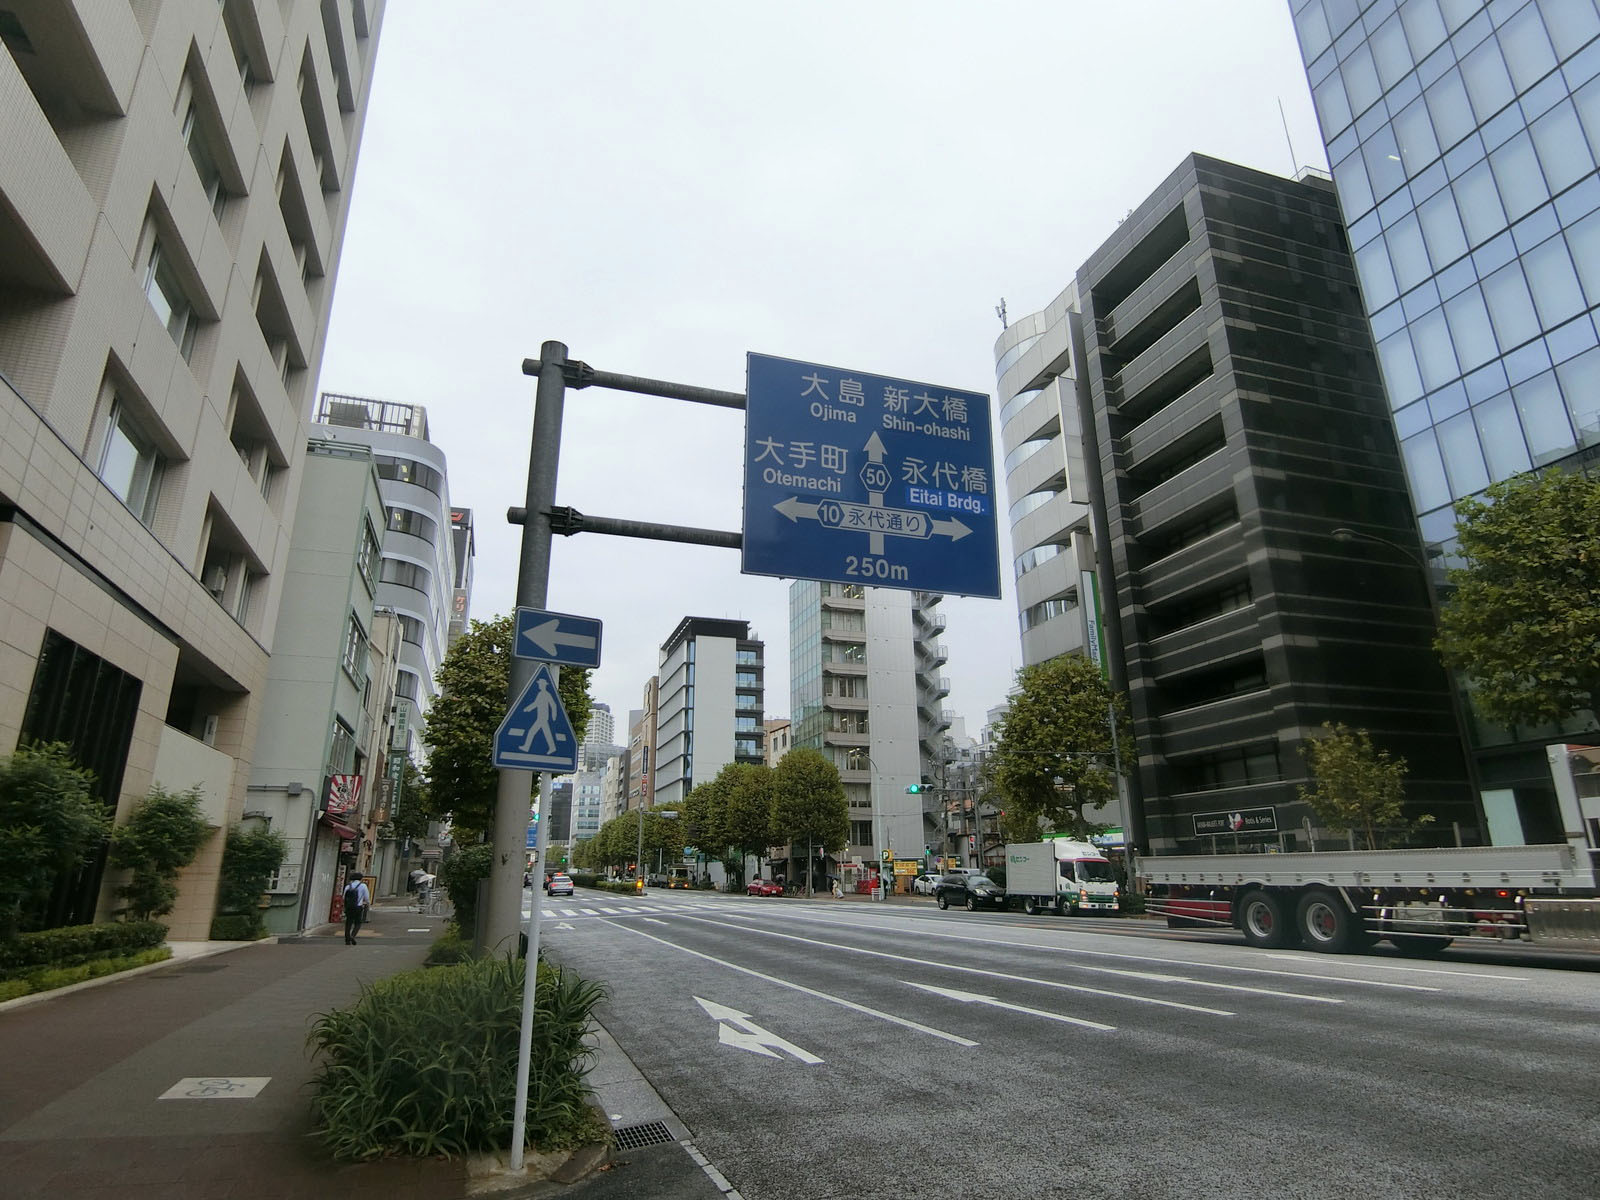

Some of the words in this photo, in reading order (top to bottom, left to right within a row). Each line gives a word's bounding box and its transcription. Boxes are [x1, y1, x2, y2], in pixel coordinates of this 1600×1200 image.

[800, 372, 865, 407] 大島
[810, 402, 857, 423] Ojima
[883, 385, 969, 424] 新大橋
[882, 414, 971, 441] Shin-ohashi
[754, 435, 849, 474] 大手町
[763, 468, 841, 493] Otemachi
[866, 469, 886, 486] 50
[901, 457, 988, 494] 永代橋
[820, 505, 840, 523] 10
[909, 489, 942, 507] Eitai
[947, 493, 985, 514] Brdg.
[849, 508, 921, 533] 永代通り
[845, 556, 909, 581] 250m
